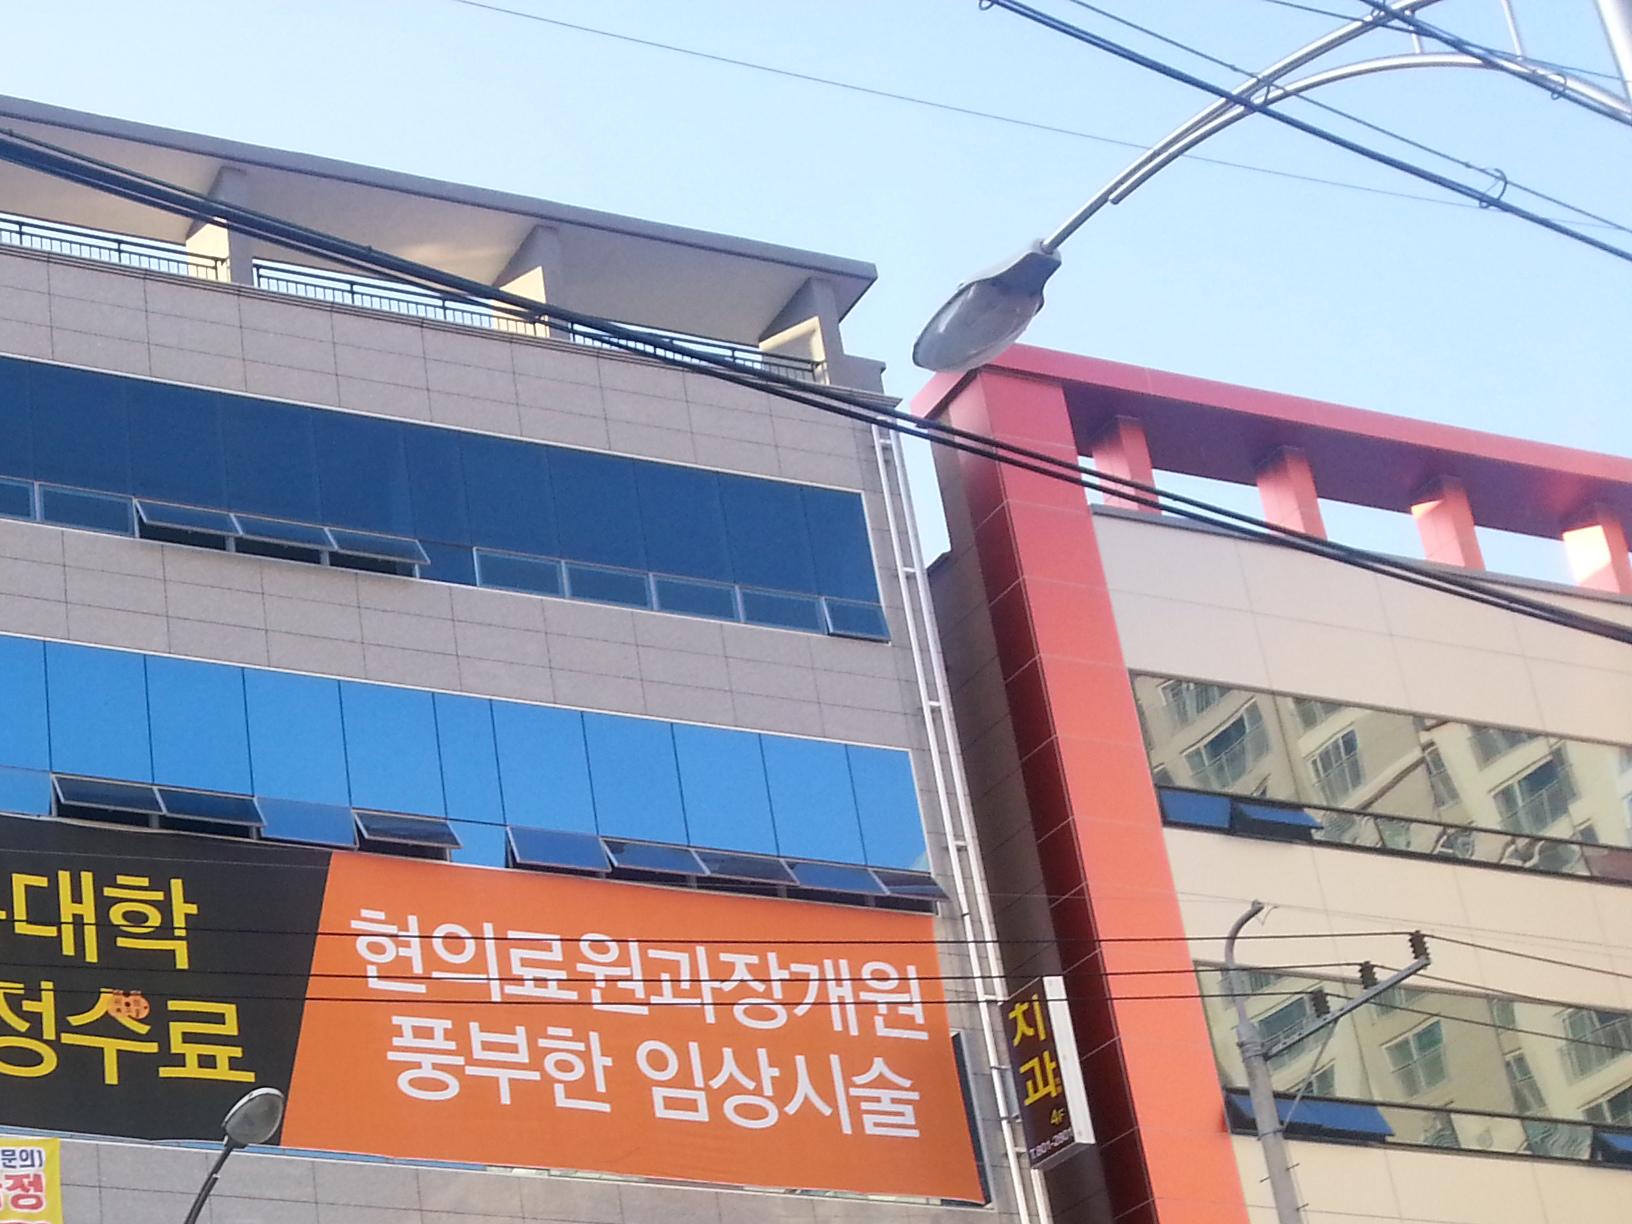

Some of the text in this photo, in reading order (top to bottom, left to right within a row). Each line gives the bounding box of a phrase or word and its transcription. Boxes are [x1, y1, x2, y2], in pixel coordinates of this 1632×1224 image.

[350, 908, 929, 1041] 현의료원과장개원
[386, 1015, 922, 1139] 풍부한 임상시술
[1008, 993, 1058, 1106] 치과
